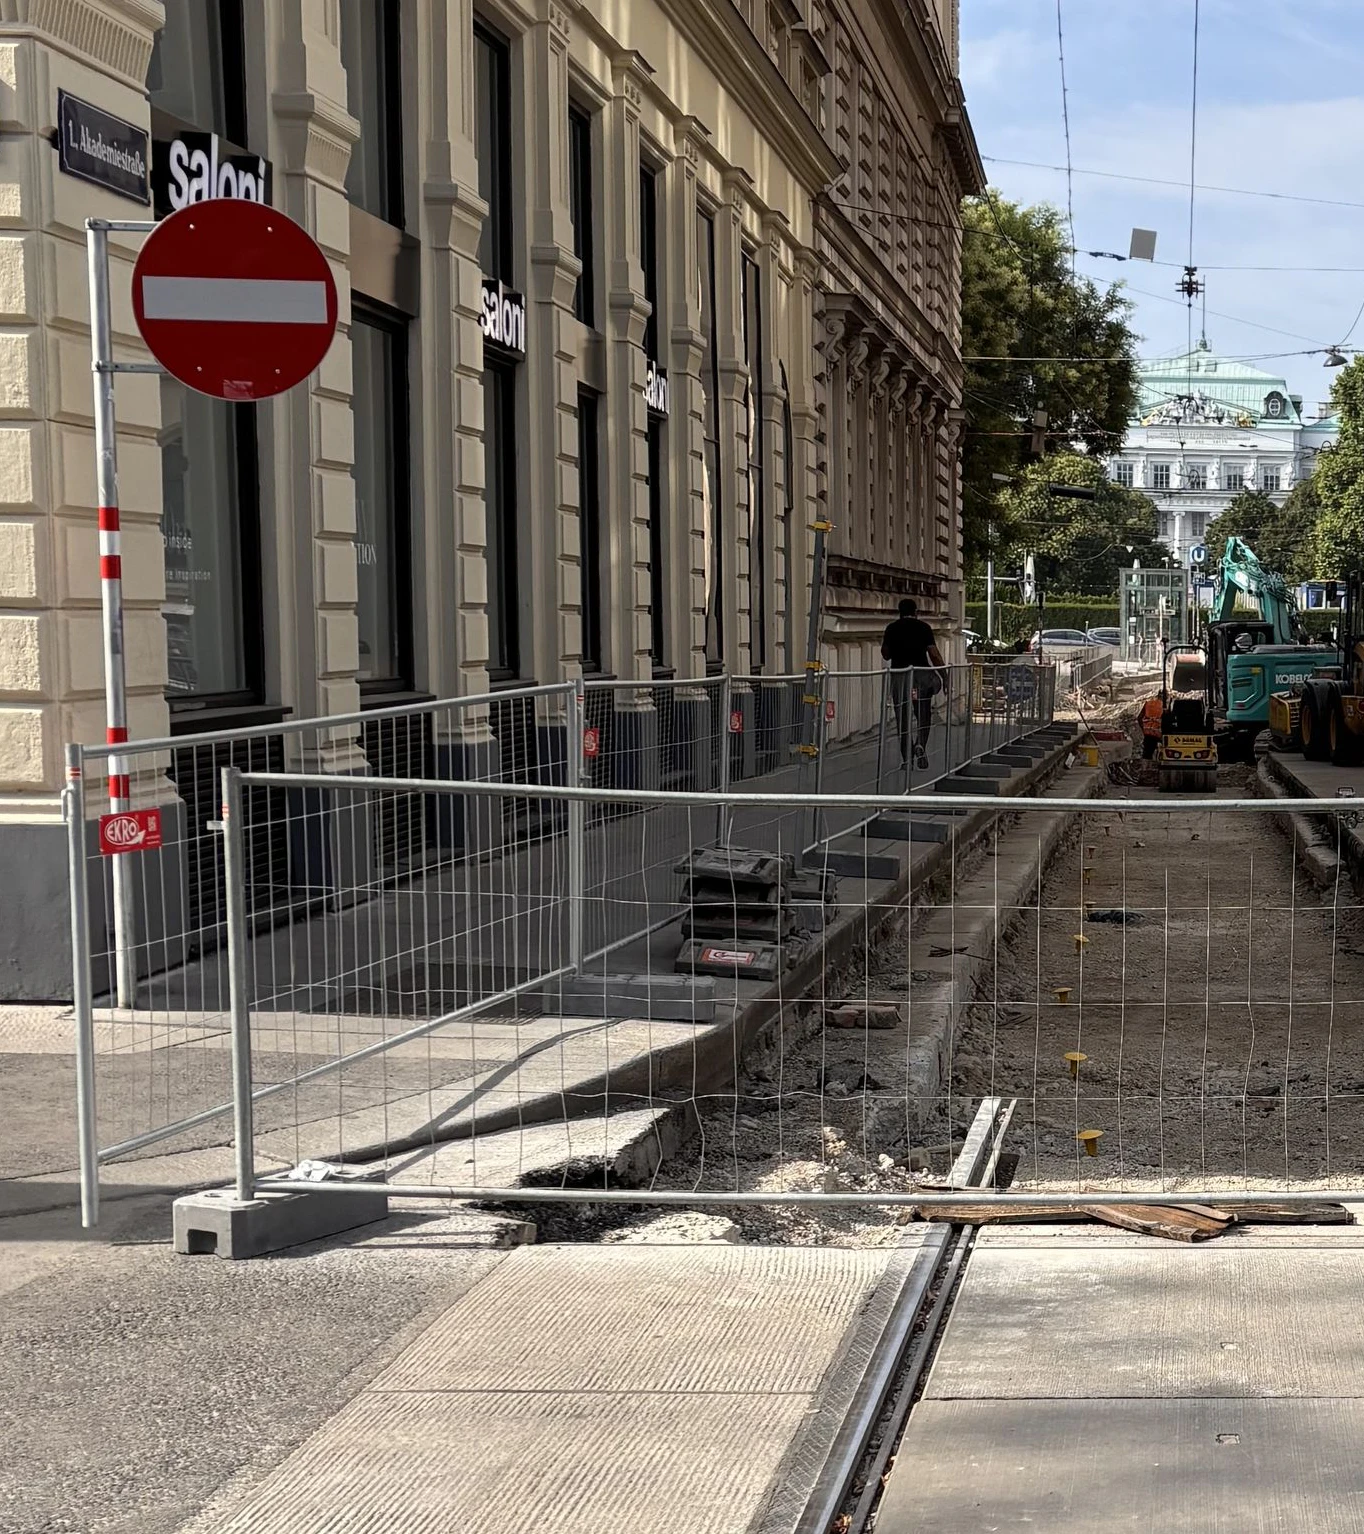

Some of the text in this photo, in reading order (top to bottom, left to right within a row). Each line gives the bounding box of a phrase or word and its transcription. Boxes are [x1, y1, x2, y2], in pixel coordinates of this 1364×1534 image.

[80, 124, 146, 179] Akademiestraße
[168, 132, 266, 210] saloni
[481, 279, 526, 353] saloni
[1193, 549, 1206, 563] U
[106, 819, 137, 842] EKRO
